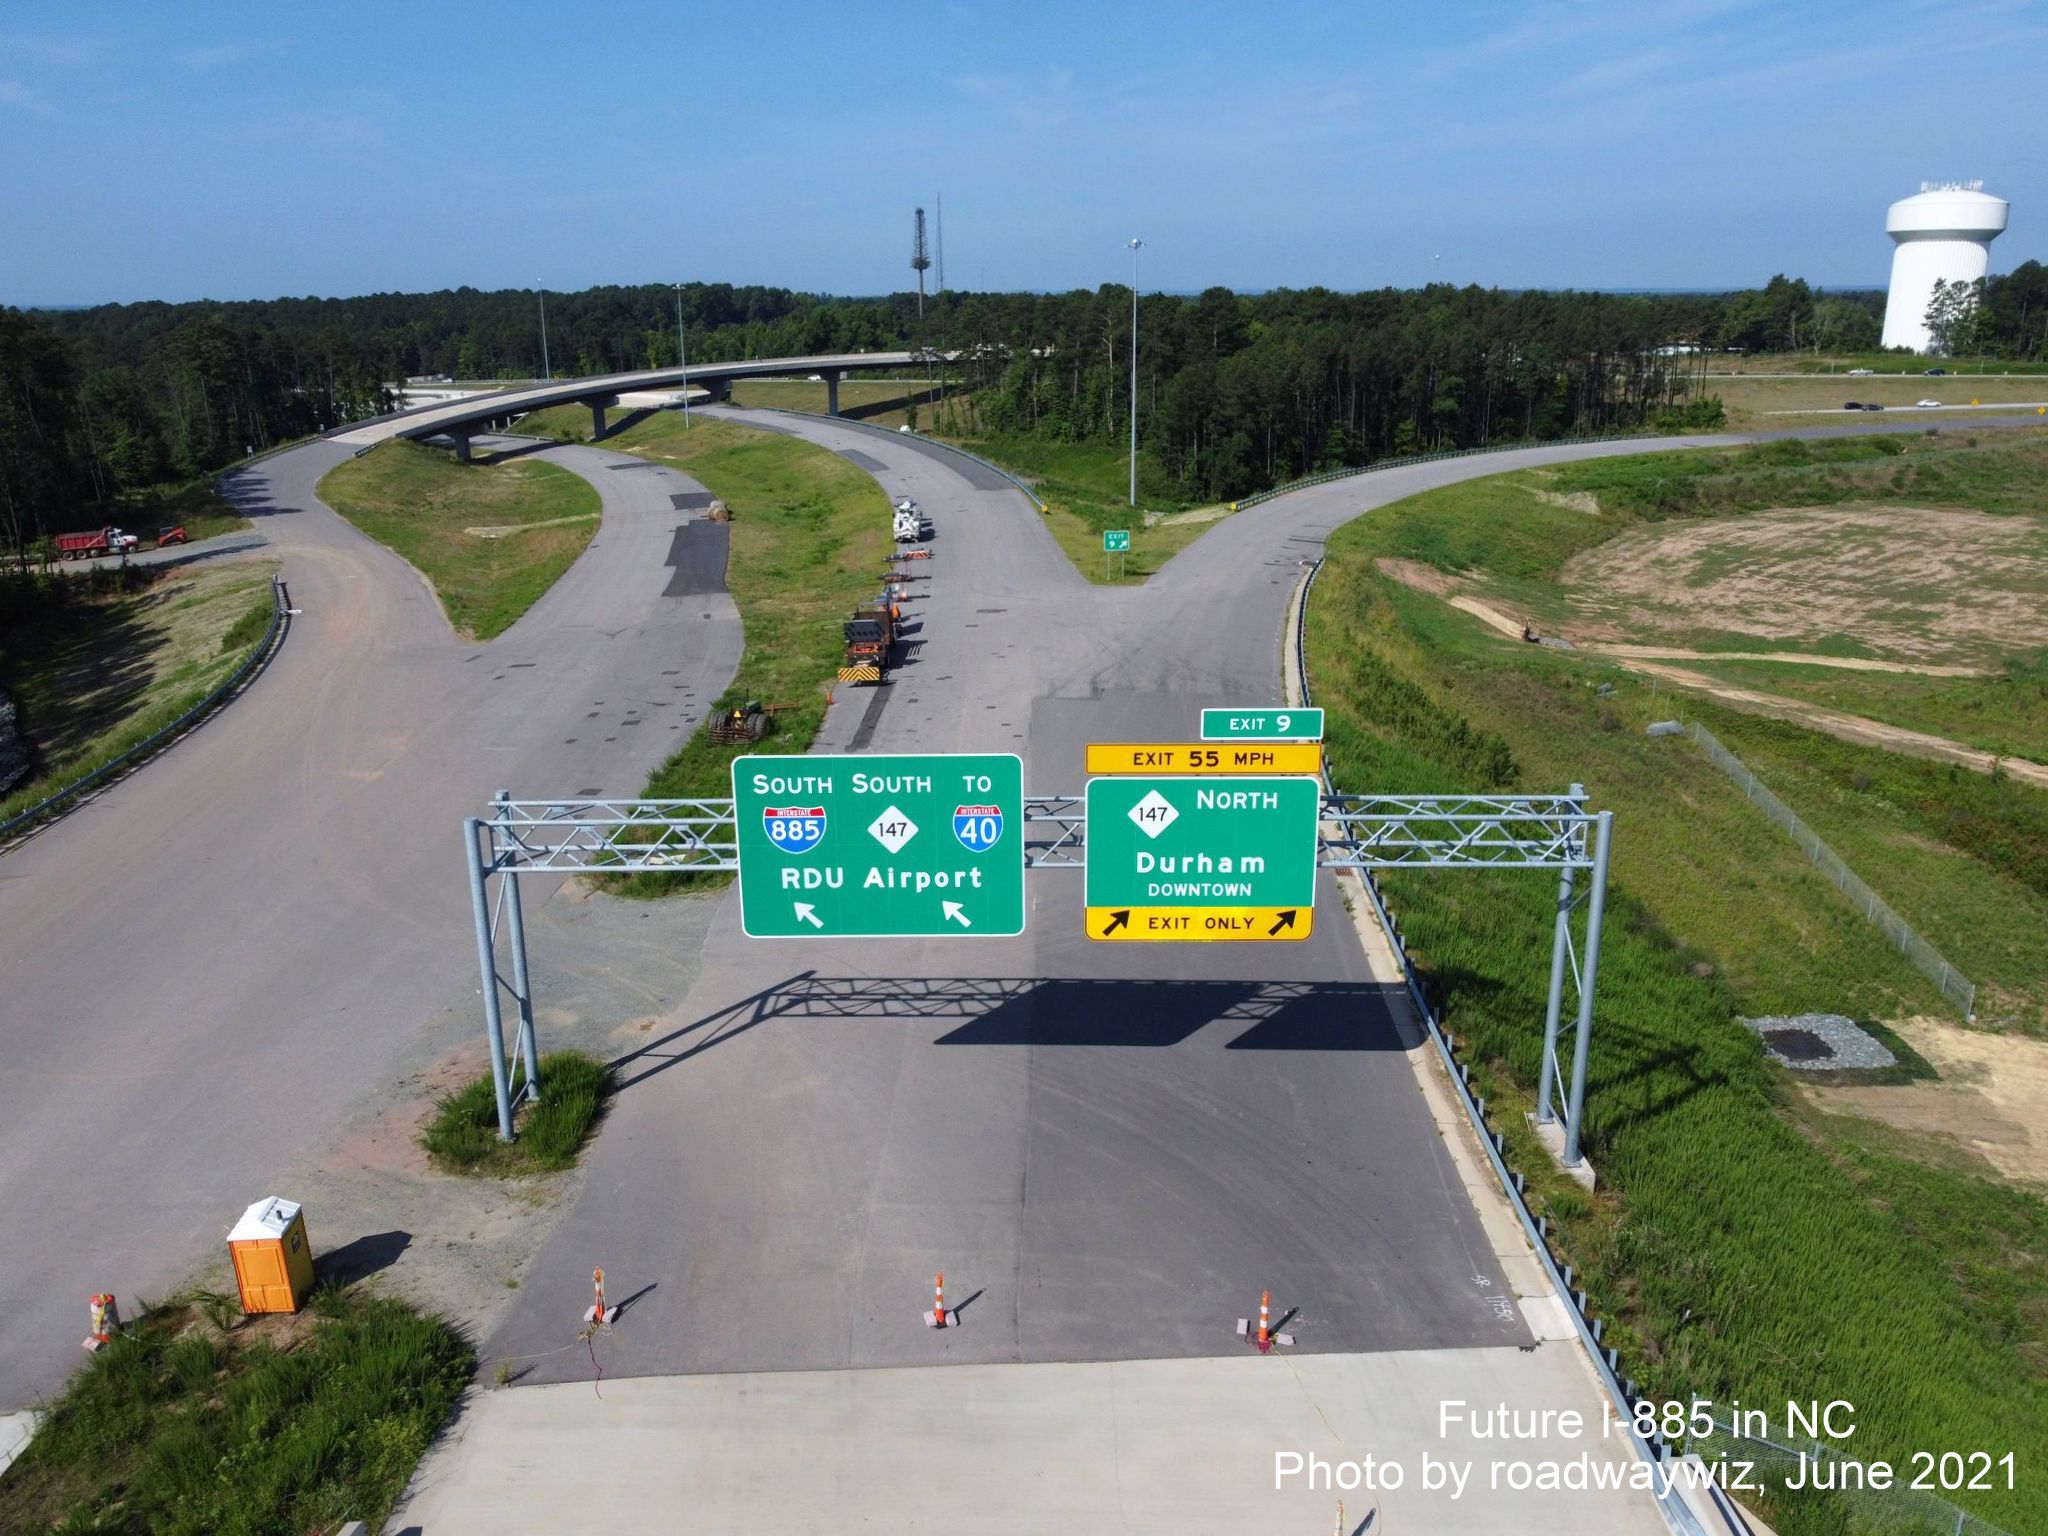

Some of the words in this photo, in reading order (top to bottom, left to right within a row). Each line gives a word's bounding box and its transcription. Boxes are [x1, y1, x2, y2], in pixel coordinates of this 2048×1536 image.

[1109, 540, 1115, 548] 9
[1230, 718, 1266, 731] EXIT
[1276, 716, 1291, 733] 9
[1133, 752, 1174, 767] EXIT
[1189, 751, 1219, 767] 55
[1234, 752, 1274, 765] MPH
[753, 774, 832, 795] SOUTH
[852, 774, 932, 794] SOUTH
[963, 776, 992, 792] TO
[1197, 790, 1278, 809] NORTH
[1138, 807, 1168, 822] 147
[771, 819, 819, 841] 885
[878, 822, 907, 837] 147
[961, 817, 997, 844] 40
[1137, 852, 1264, 873] Durham
[782, 867, 844, 889] RDU
[863, 867, 982, 892] Airport
[1149, 883, 1251, 896] DOWNTOWN
[1150, 917, 1190, 930] EXIT
[1205, 917, 1255, 930] ONLY
